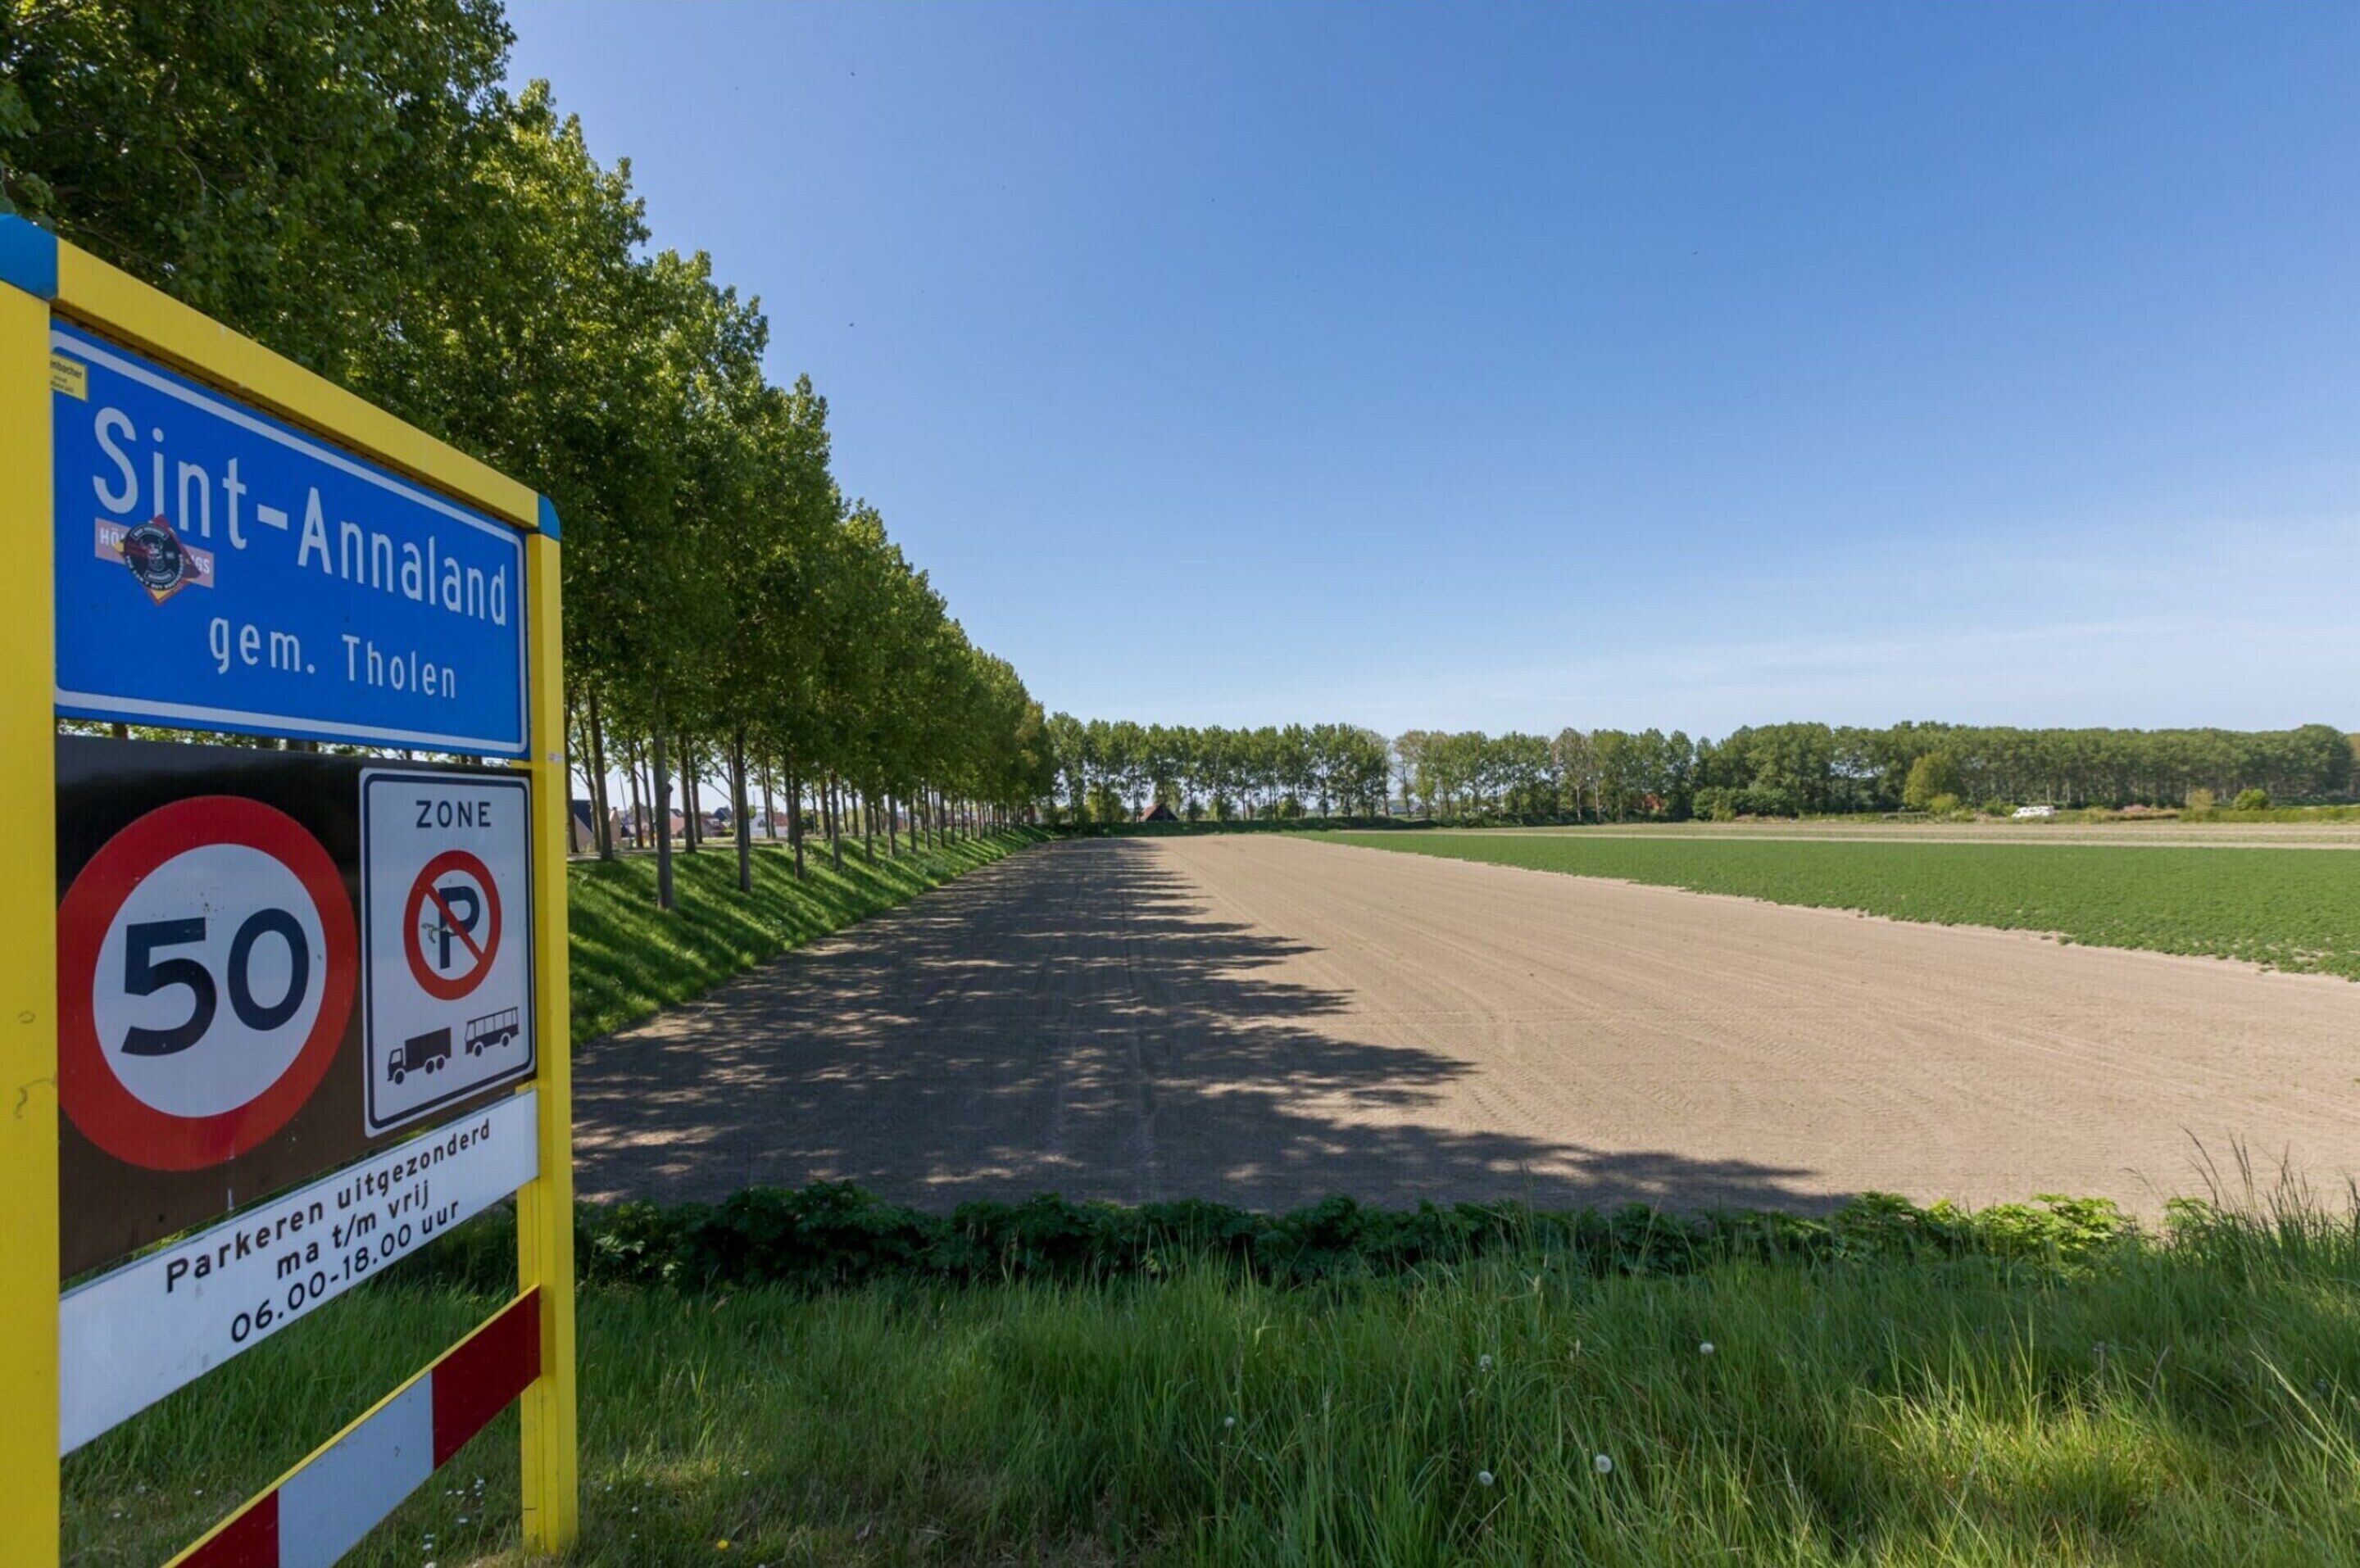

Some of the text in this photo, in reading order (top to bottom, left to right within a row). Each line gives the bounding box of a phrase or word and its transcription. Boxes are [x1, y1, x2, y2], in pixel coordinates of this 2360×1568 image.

[93, 406, 506, 627] Sint-Annaland
[209, 617, 456, 699] gem. Tholen
[415, 800, 492, 829] ZONE
[120, 908, 311, 1057] 50
[166, 1118, 491, 1294] Parkeren uitgezonderd
[230, 1200, 460, 1344] 06.00-18.00 uur
[276, 1180, 430, 1280] ma t/m vrij
